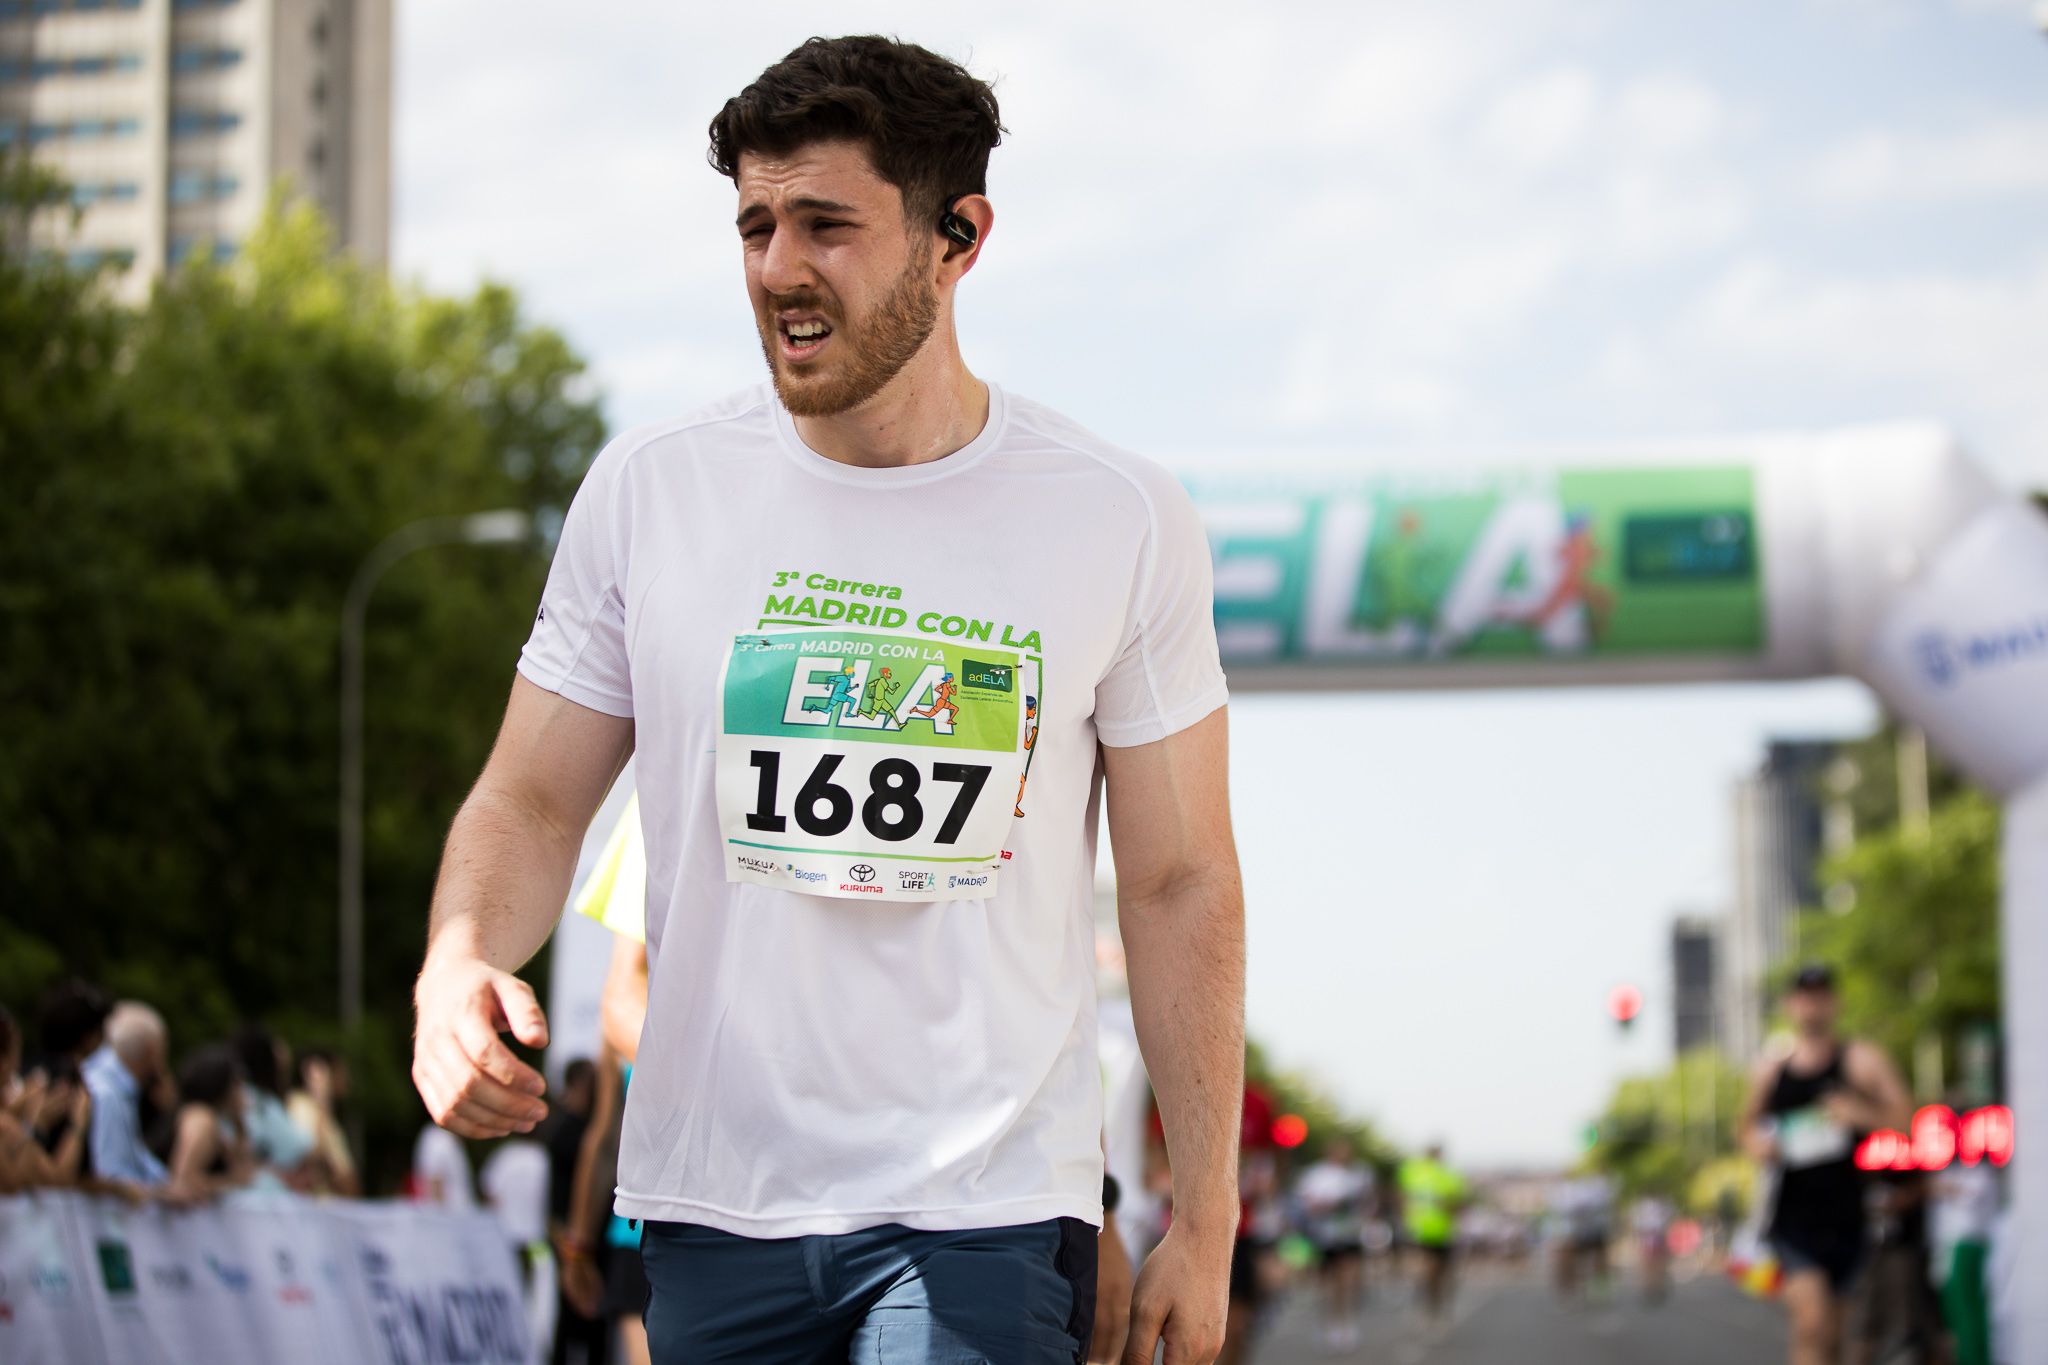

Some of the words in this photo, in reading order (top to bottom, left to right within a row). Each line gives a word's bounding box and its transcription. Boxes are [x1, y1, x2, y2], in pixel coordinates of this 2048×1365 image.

[771, 571, 800, 588] 3ª
[805, 572, 903, 601] Carrera
[763, 594, 908, 629] MADRID
[916, 612, 994, 642] CON
[1000, 624, 1042, 653] LA
[799, 640, 875, 656] MADRID
[878, 643, 918, 660] CON
[922, 647, 945, 662] LA
[968, 673, 1006, 687] adELA
[781, 656, 955, 735] ELA
[745, 750, 992, 844] 1687
[795, 869, 827, 882] Biogen
[898, 870, 929, 880] SPORT
[957, 876, 988, 887] MADRID
[902, 880, 924, 890] LIFE
